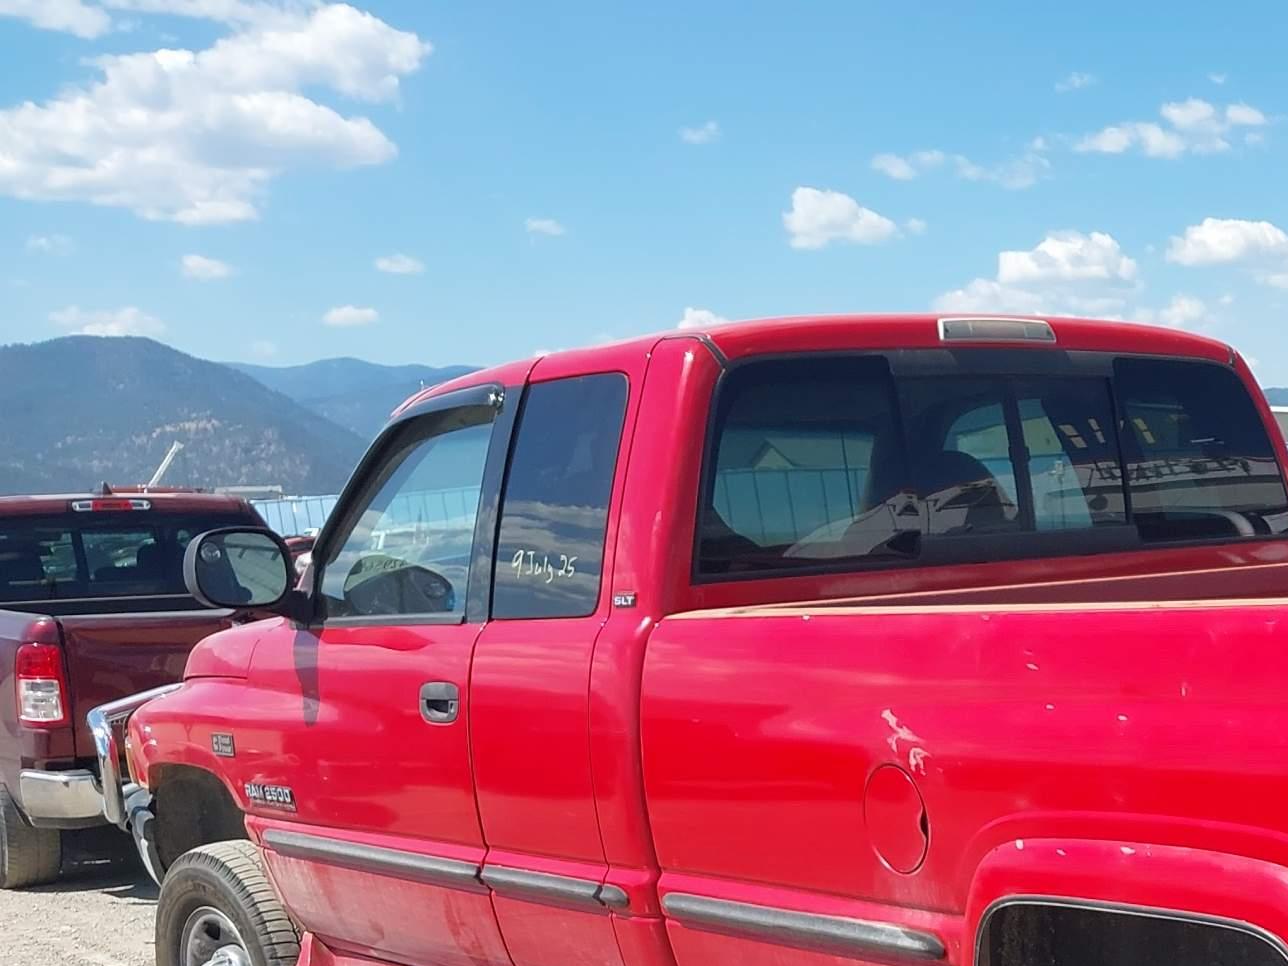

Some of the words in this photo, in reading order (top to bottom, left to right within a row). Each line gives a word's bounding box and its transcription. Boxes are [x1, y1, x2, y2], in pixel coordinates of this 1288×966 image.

[512, 550, 524, 579] 9
[526, 551, 553, 584] July
[558, 555, 578, 577] 25
[614, 596, 635, 606] SLT
[244, 783, 263, 799] RAM
[264, 786, 291, 803] 2500
